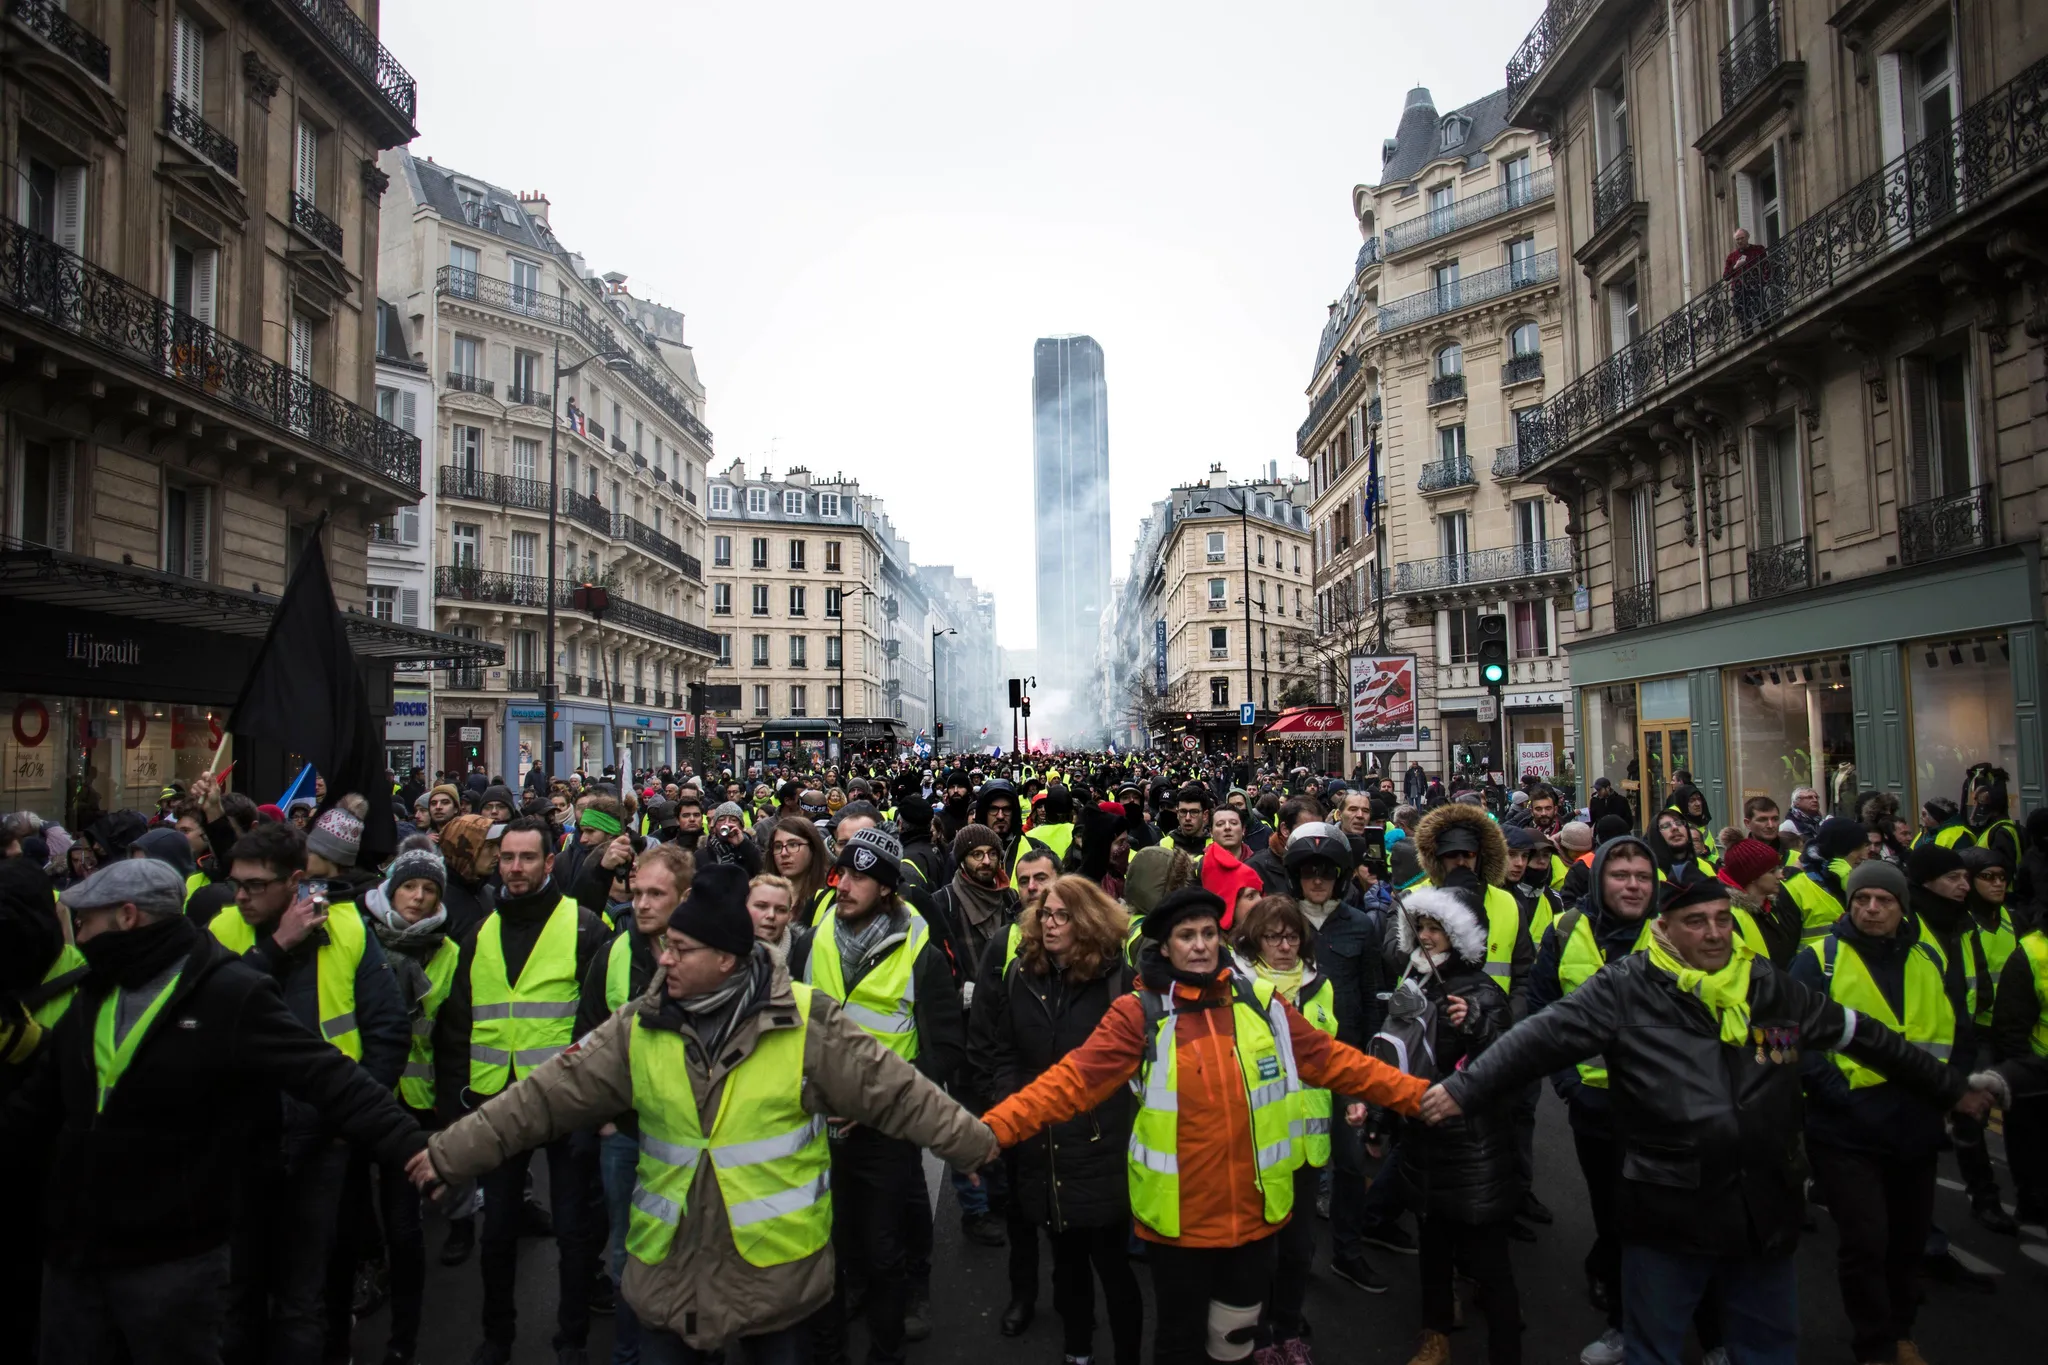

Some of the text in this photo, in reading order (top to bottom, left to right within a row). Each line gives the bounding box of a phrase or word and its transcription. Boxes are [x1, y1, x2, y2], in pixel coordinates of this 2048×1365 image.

[67, 632, 140, 667] Lipault
[1514, 694, 1555, 704] IZAC
[394, 702, 427, 716] STOCKS
[1244, 706, 1251, 722] P
[13, 762, 44, 777] -40%
[1522, 765, 1549, 776] -60%
